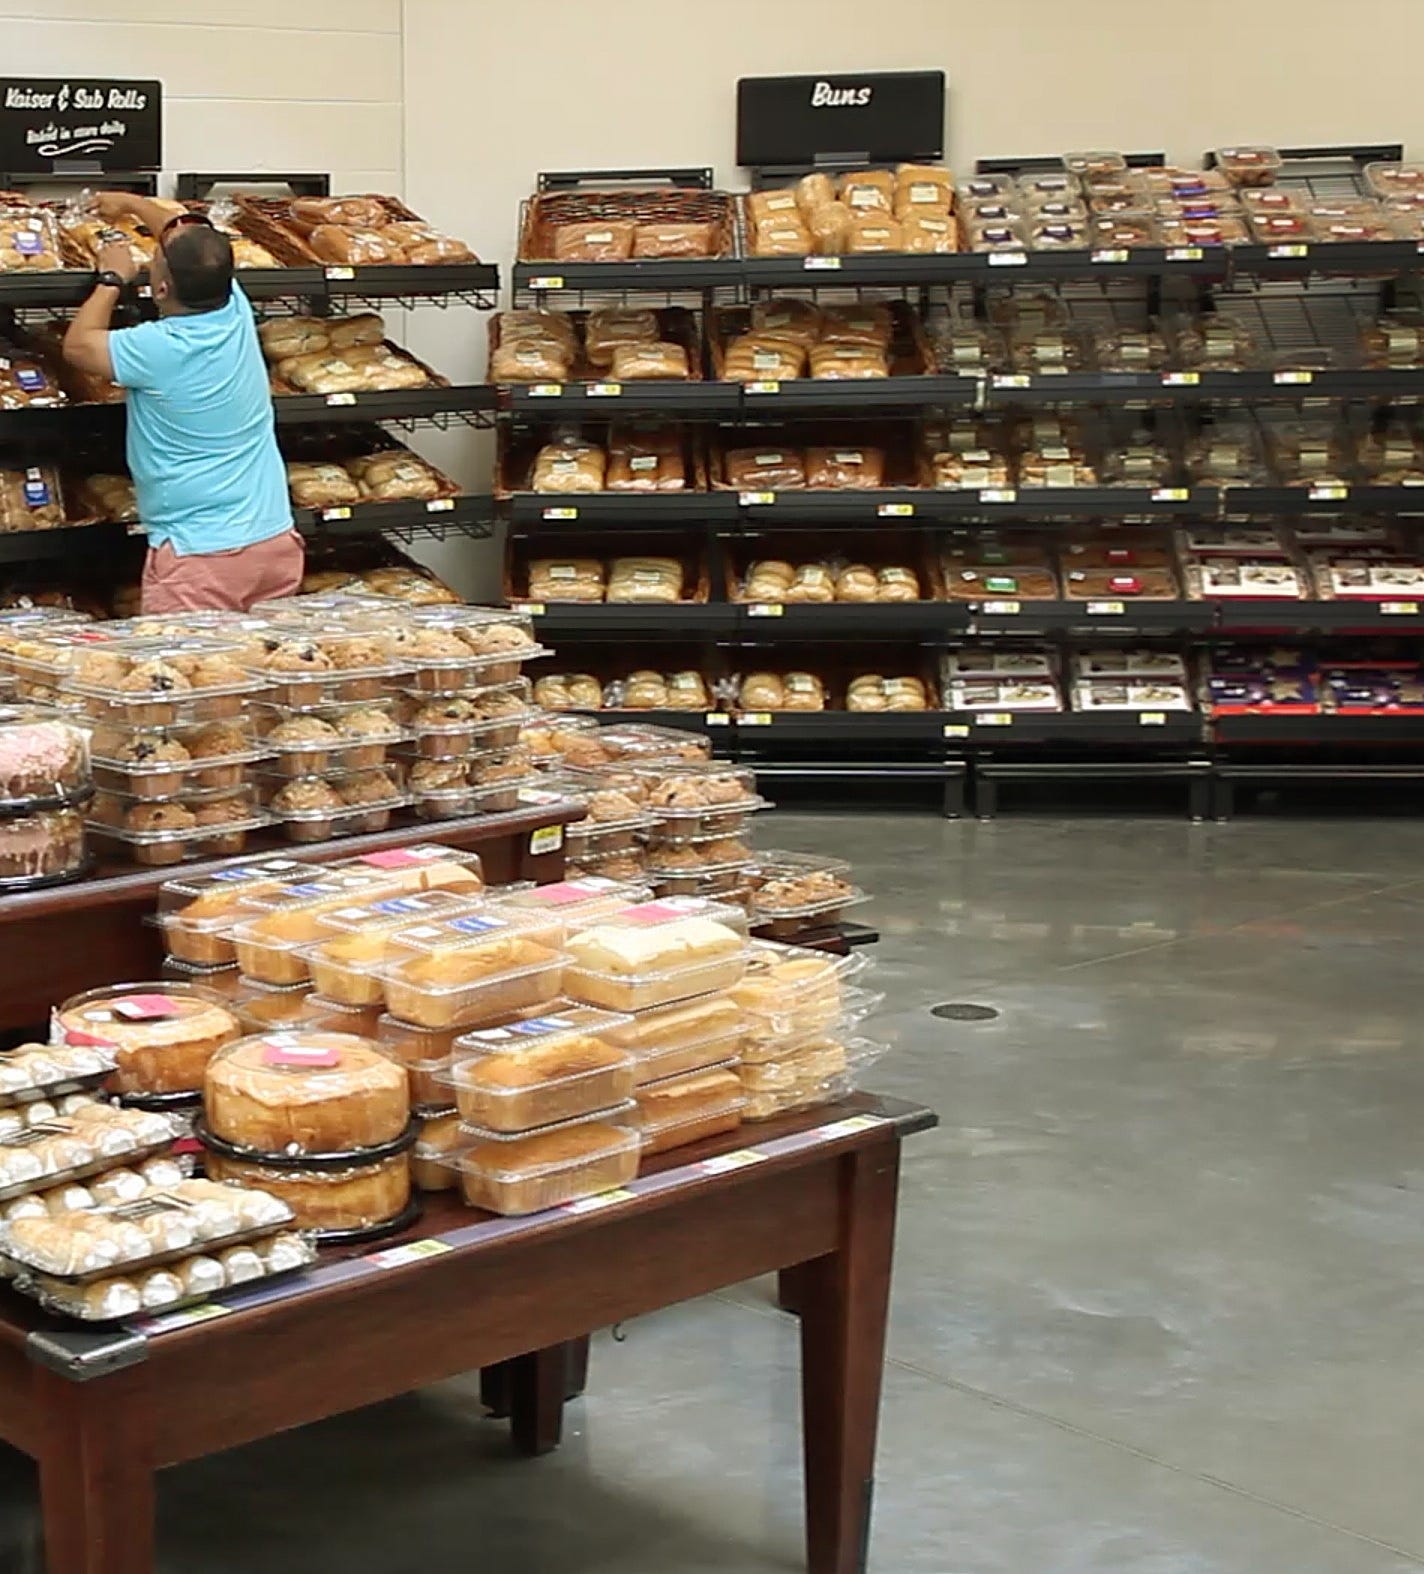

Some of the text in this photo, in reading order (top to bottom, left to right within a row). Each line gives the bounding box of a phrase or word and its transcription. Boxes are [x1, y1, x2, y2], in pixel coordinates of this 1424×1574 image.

[5, 87, 55, 108] Kaiser
[72, 88, 104, 109] Sub
[107, 88, 147, 109] Rolls
[811, 82, 872, 107] Buns
